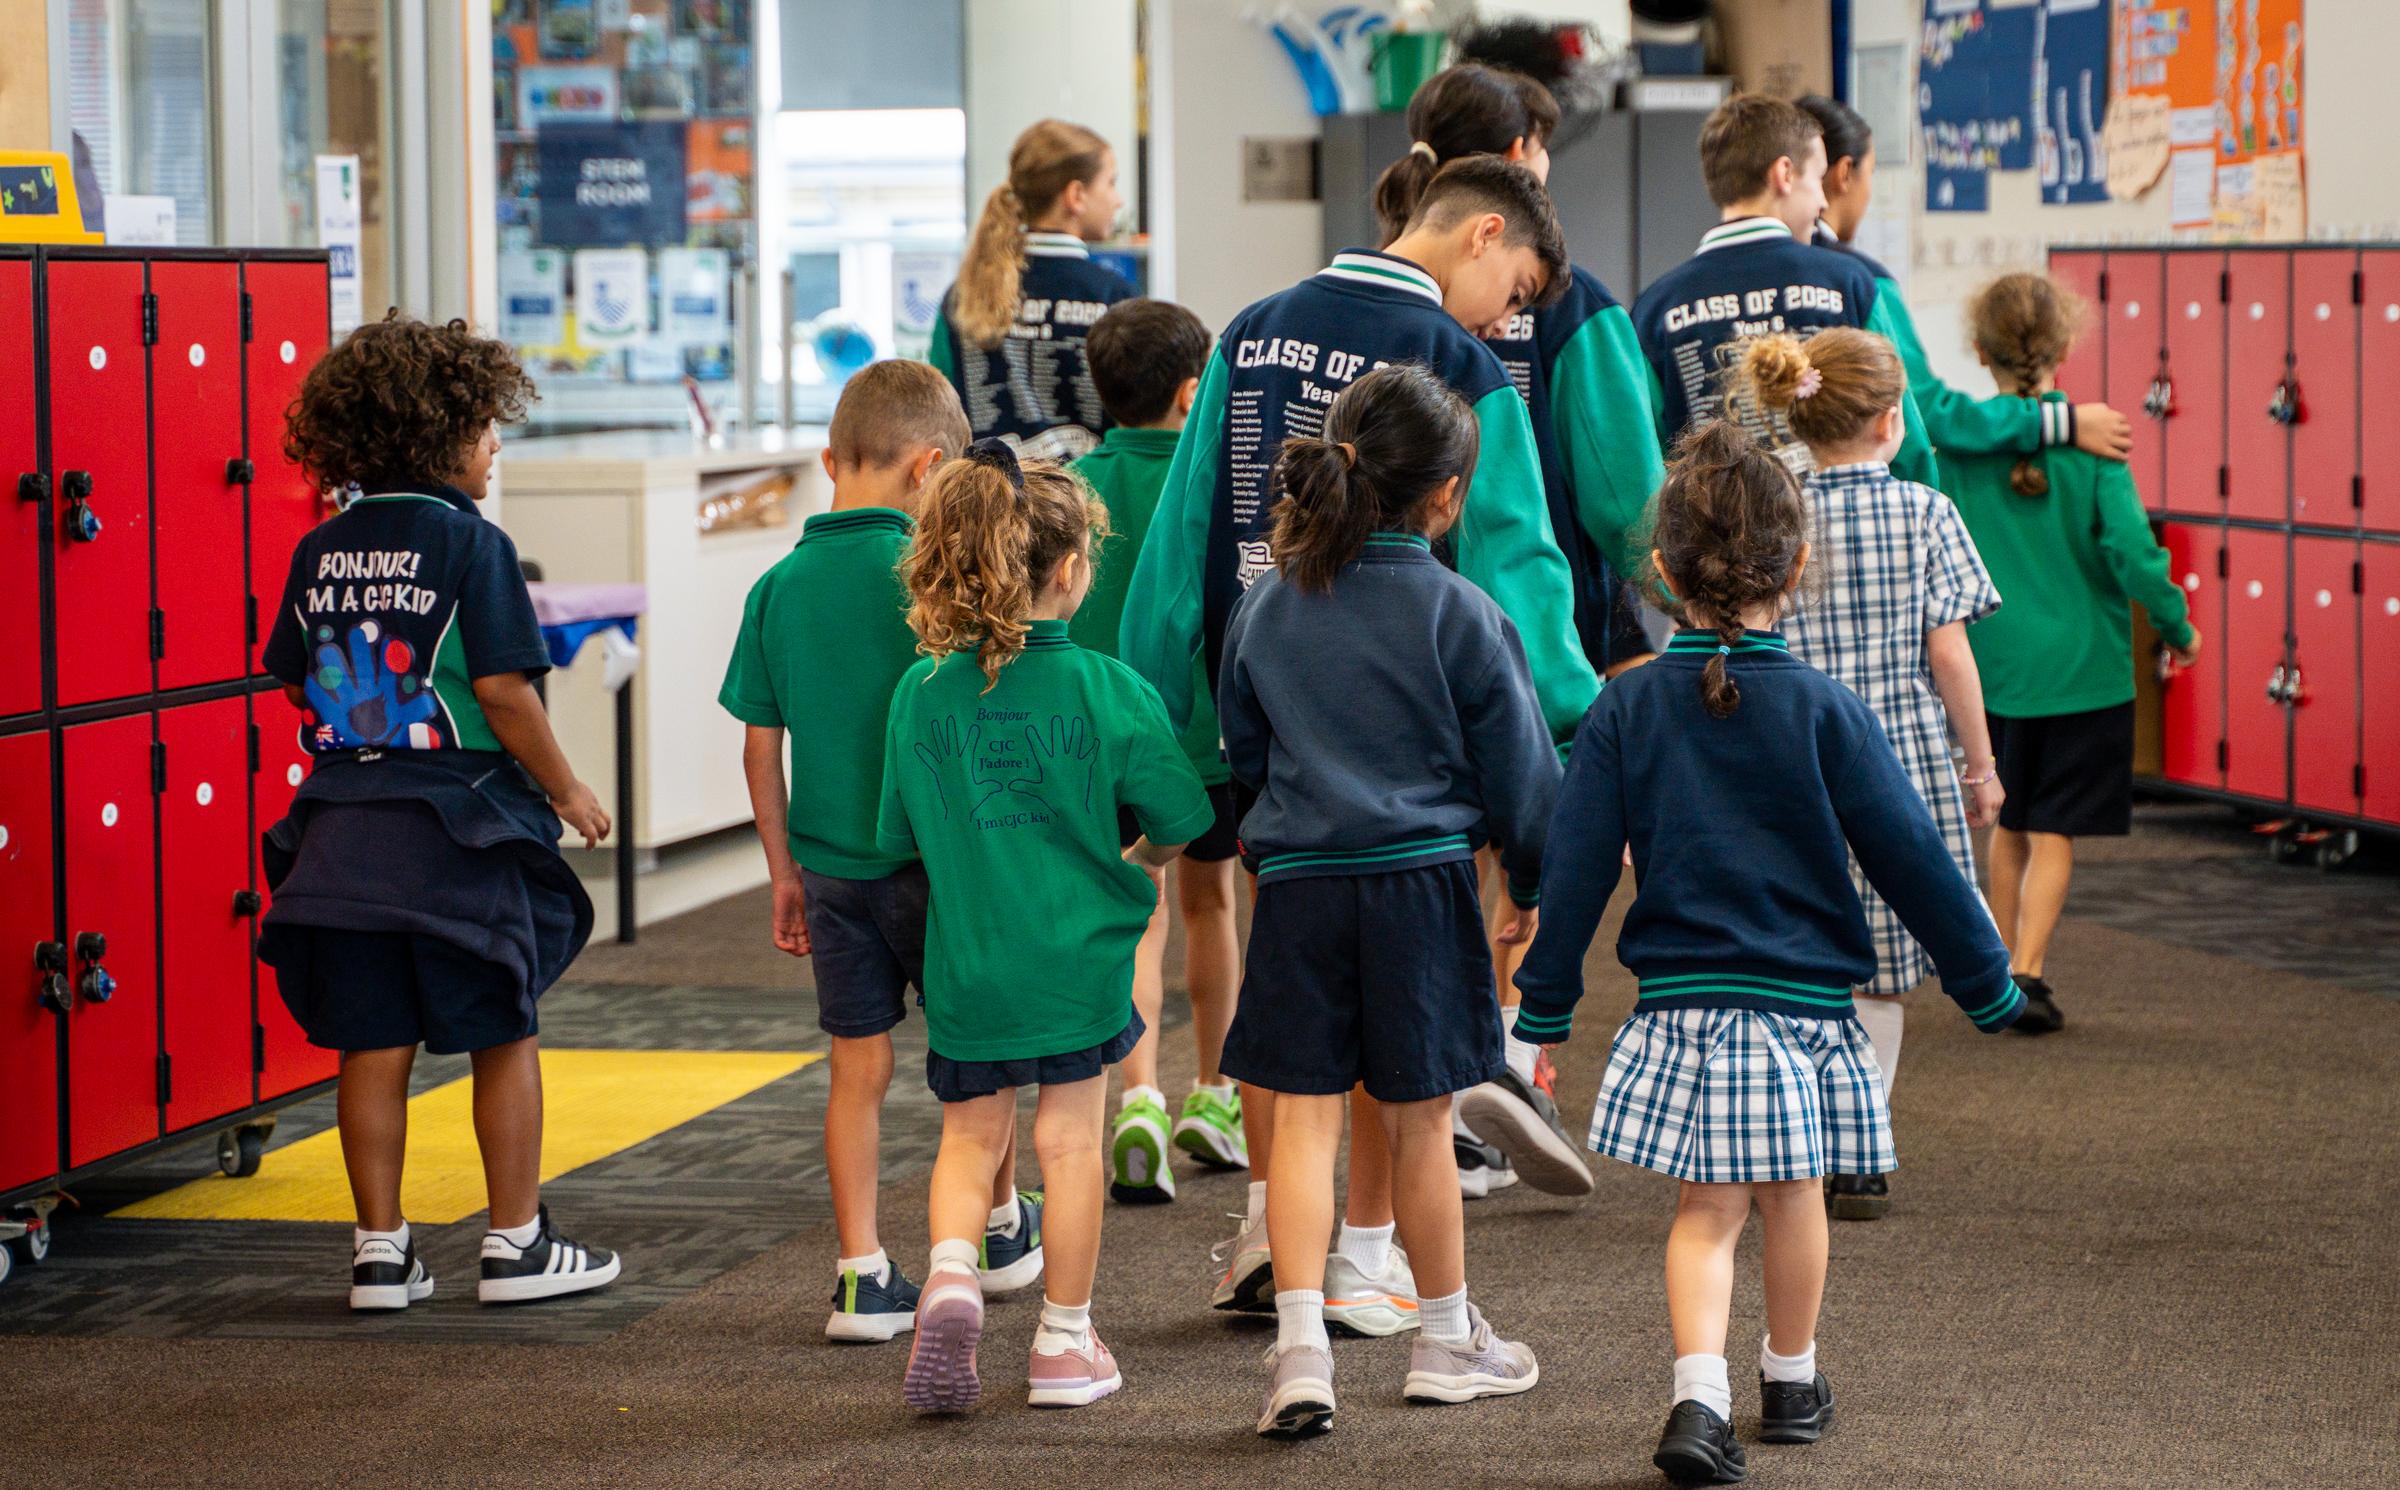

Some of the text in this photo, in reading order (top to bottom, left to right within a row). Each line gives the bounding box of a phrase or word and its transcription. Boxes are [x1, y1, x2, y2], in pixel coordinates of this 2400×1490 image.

[581, 158, 646, 180] STEM
[577, 181, 651, 206] ROOM
[1664, 284, 1843, 333] CLASS OF 2026
[1504, 313, 1535, 341] 26
[1733, 315, 1785, 338] Year 6
[1236, 338, 1365, 382] CLASS OF
[317, 550, 421, 579] BONJOUR!
[305, 584, 335, 613] 'M
[341, 584, 359, 612] A
[976, 707, 1032, 725] Bonjour
[988, 740, 1015, 753] CJC
[1004, 813, 1028, 829] CJC
[1030, 811, 1050, 825] kid
[363, 1246, 391, 1255] adidas
